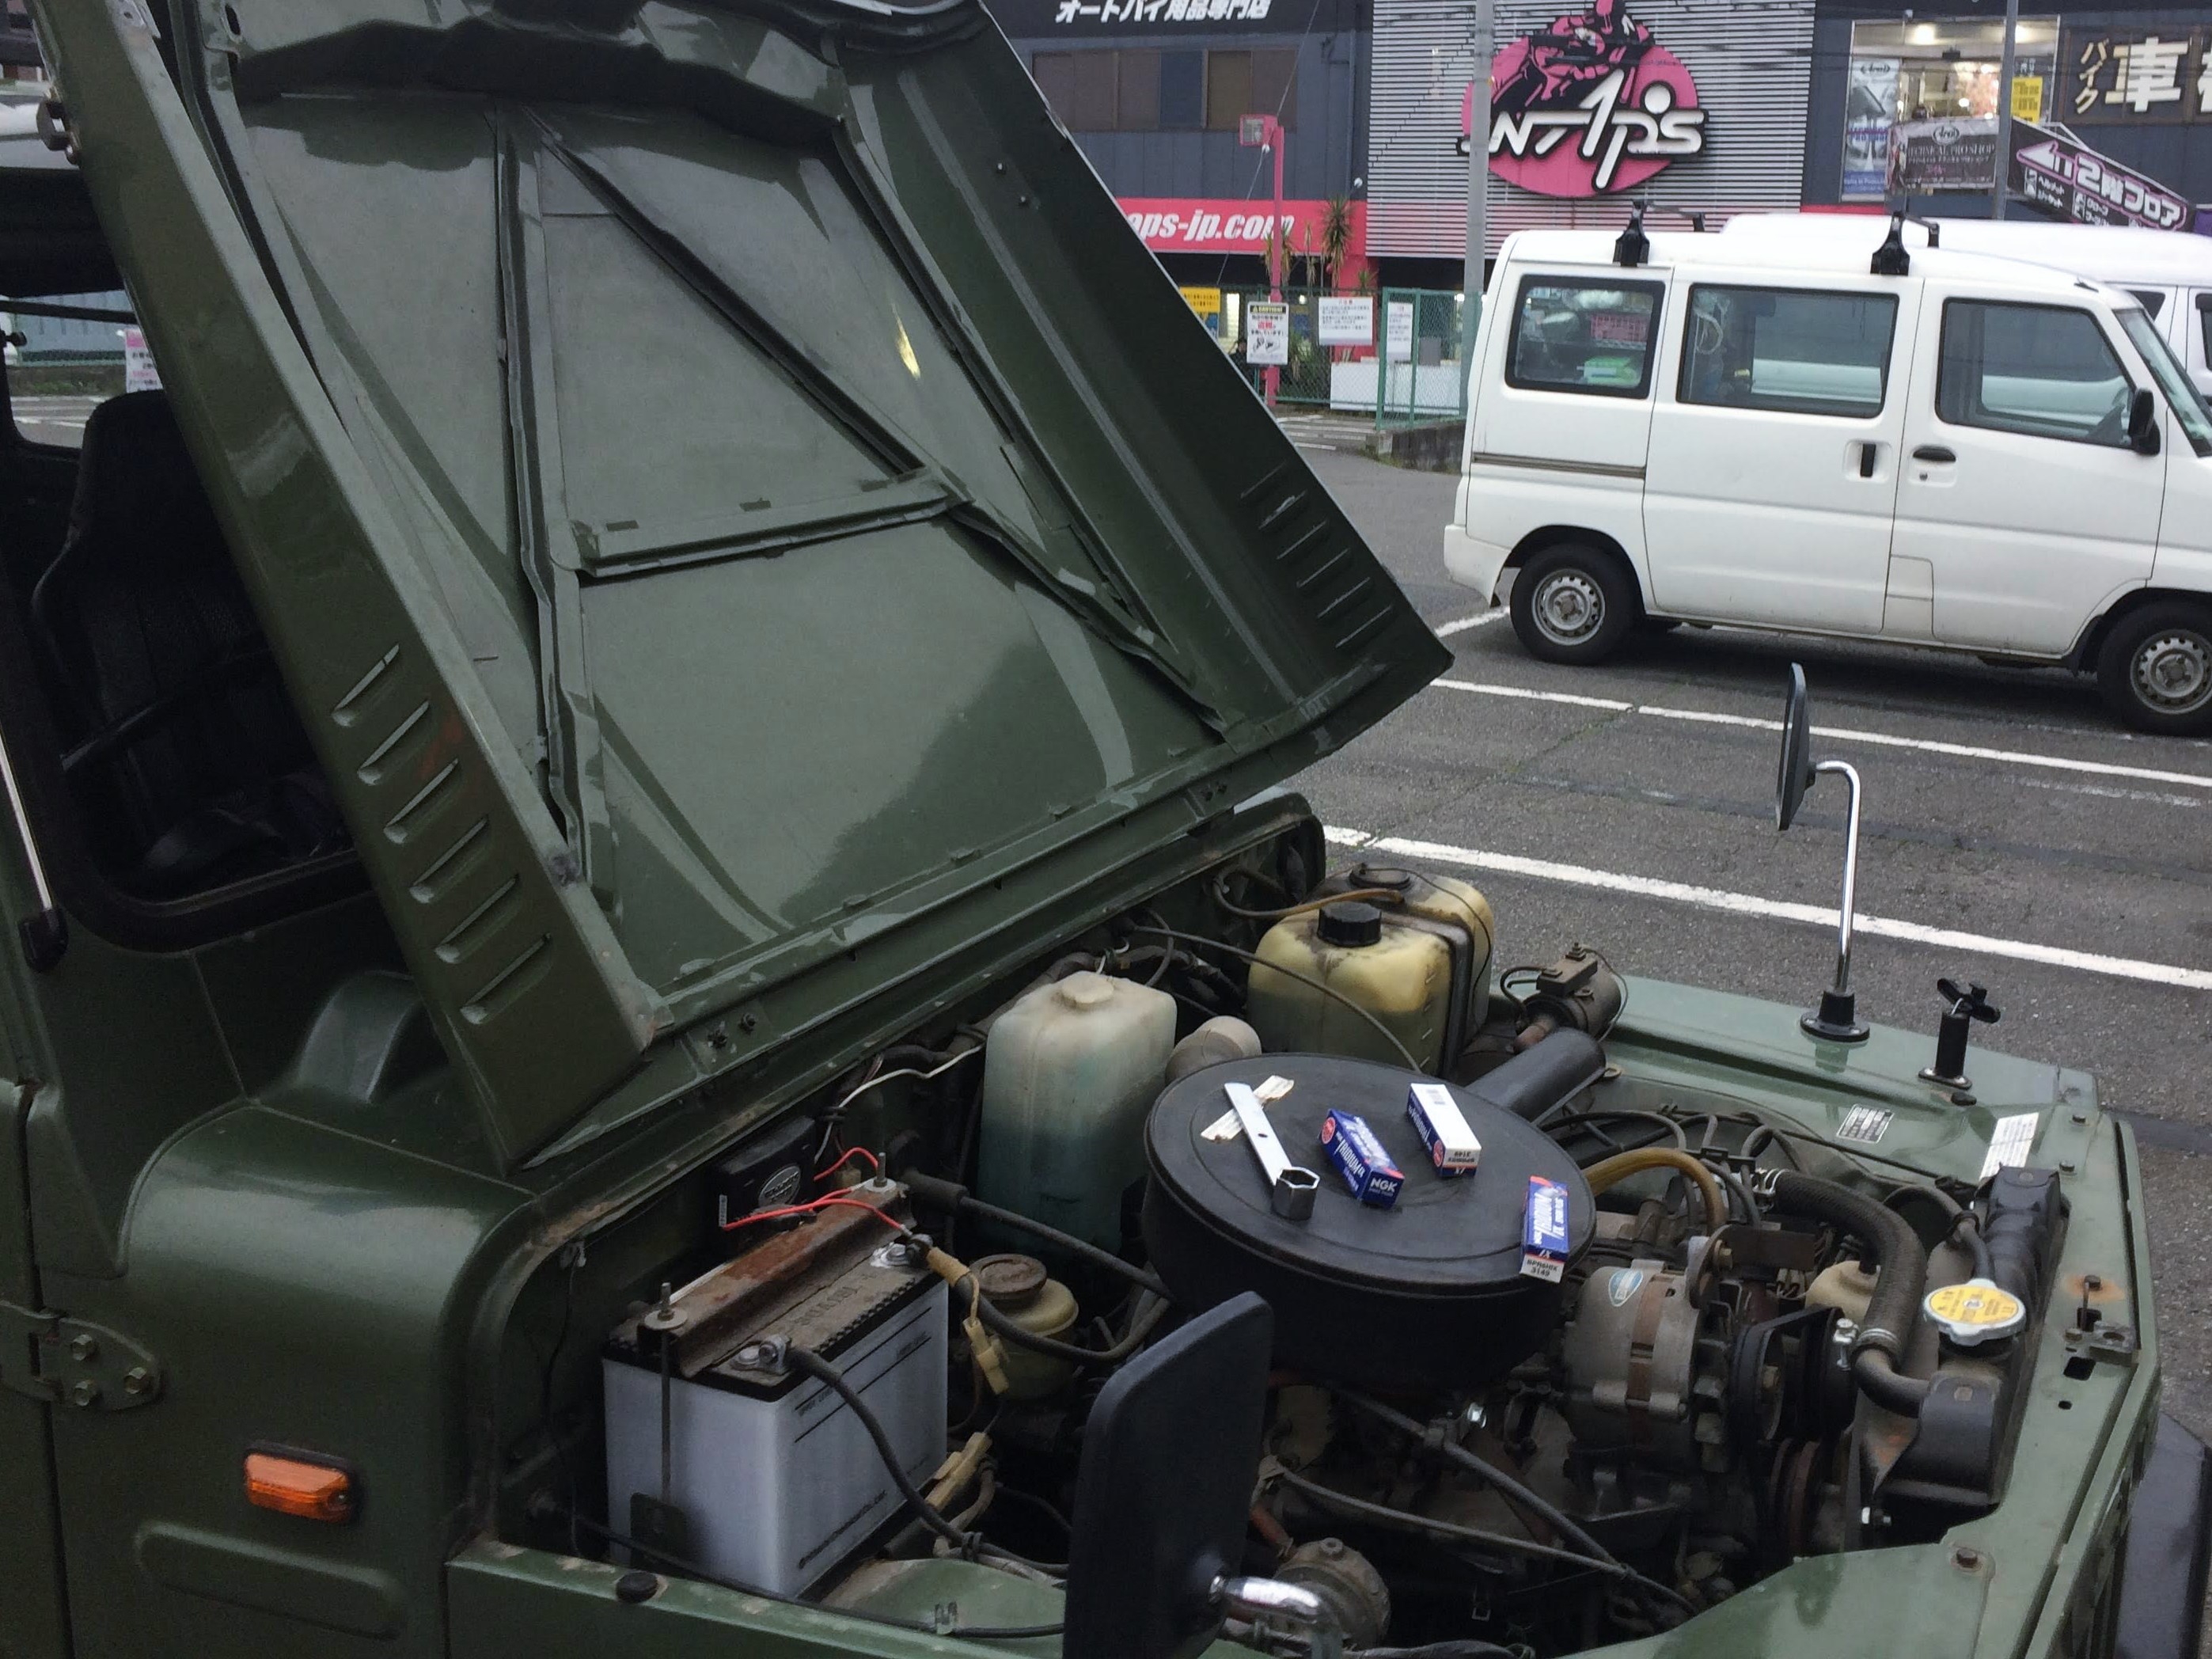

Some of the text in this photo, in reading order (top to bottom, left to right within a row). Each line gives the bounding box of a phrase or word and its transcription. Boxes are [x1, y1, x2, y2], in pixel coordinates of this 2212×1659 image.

[2074, 38, 2111, 115] バイク
[2105, 36, 2212, 112] 車
[1371, 1177, 1398, 1194] NGK
[1531, 1267, 1551, 1277] 3149
